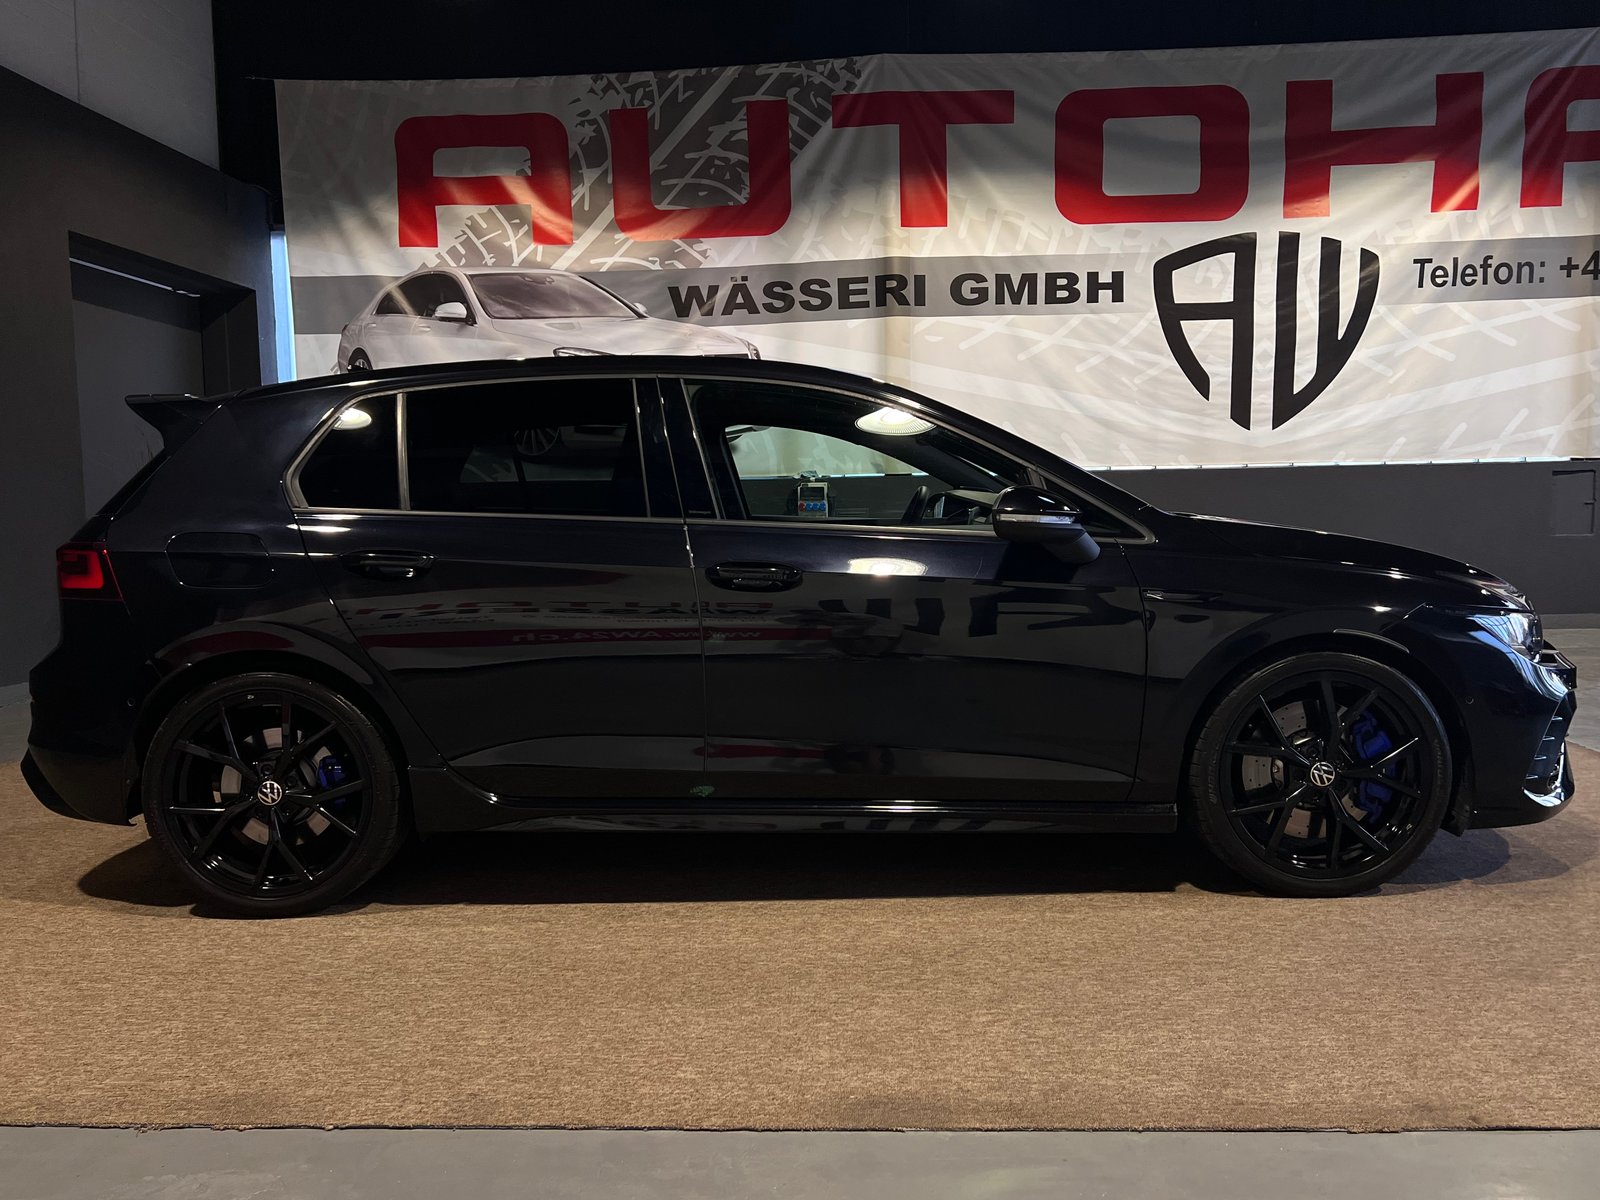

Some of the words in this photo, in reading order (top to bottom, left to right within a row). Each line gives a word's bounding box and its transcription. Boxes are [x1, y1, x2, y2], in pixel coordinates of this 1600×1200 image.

[1413, 255, 1546, 289] Telefon:
[1559, 250, 1600, 281] +4
[667, 273, 927, 318] WÄSSERI
[949, 271, 1125, 305] GMBH
